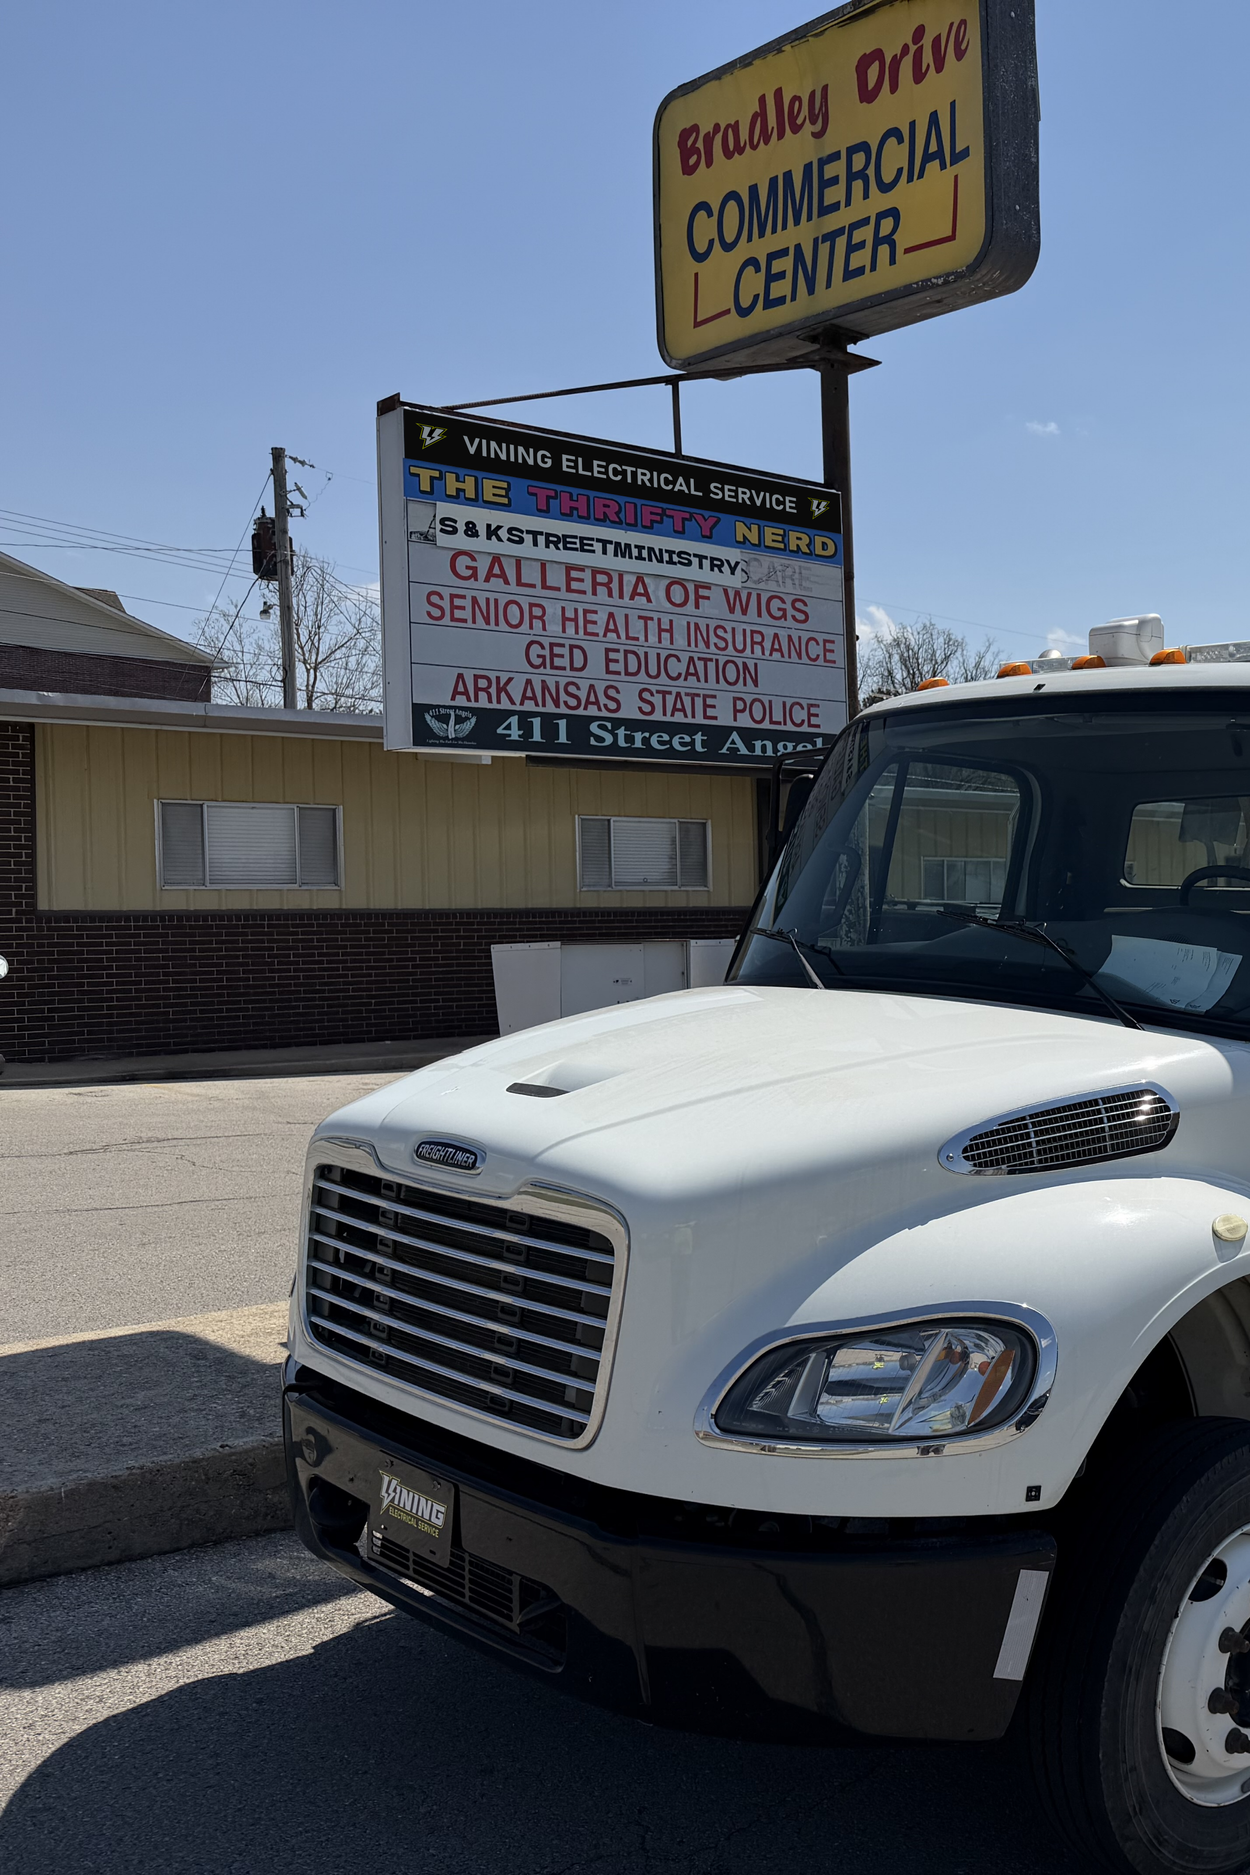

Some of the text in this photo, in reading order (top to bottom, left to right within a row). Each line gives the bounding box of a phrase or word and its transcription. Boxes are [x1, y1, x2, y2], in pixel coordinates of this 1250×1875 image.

[677, 18, 969, 177] Bradley Drive
[686, 99, 970, 264] COMMERCIAL
[733, 206, 901, 318] CENTER
[409, 465, 837, 558] THE THRIFTY NERD
[463, 435, 797, 513] VINING ELECTRICAL SERVICE
[438, 517, 459, 536] S
[449, 550, 810, 625] GALLERIA OF WIGS
[425, 590, 837, 665] SENIOR HEALTH INSURANCE
[524, 639, 759, 688] GED EDUCATION
[449, 673, 821, 729] ARKANSAS STATE POLICE
[496, 714, 572, 744] 411
[589, 720, 708, 753] Street
[417, 1144, 475, 1167] FREIGHTLINER
[389, 1506, 439, 1539] ELECTRICAL SERVICE
